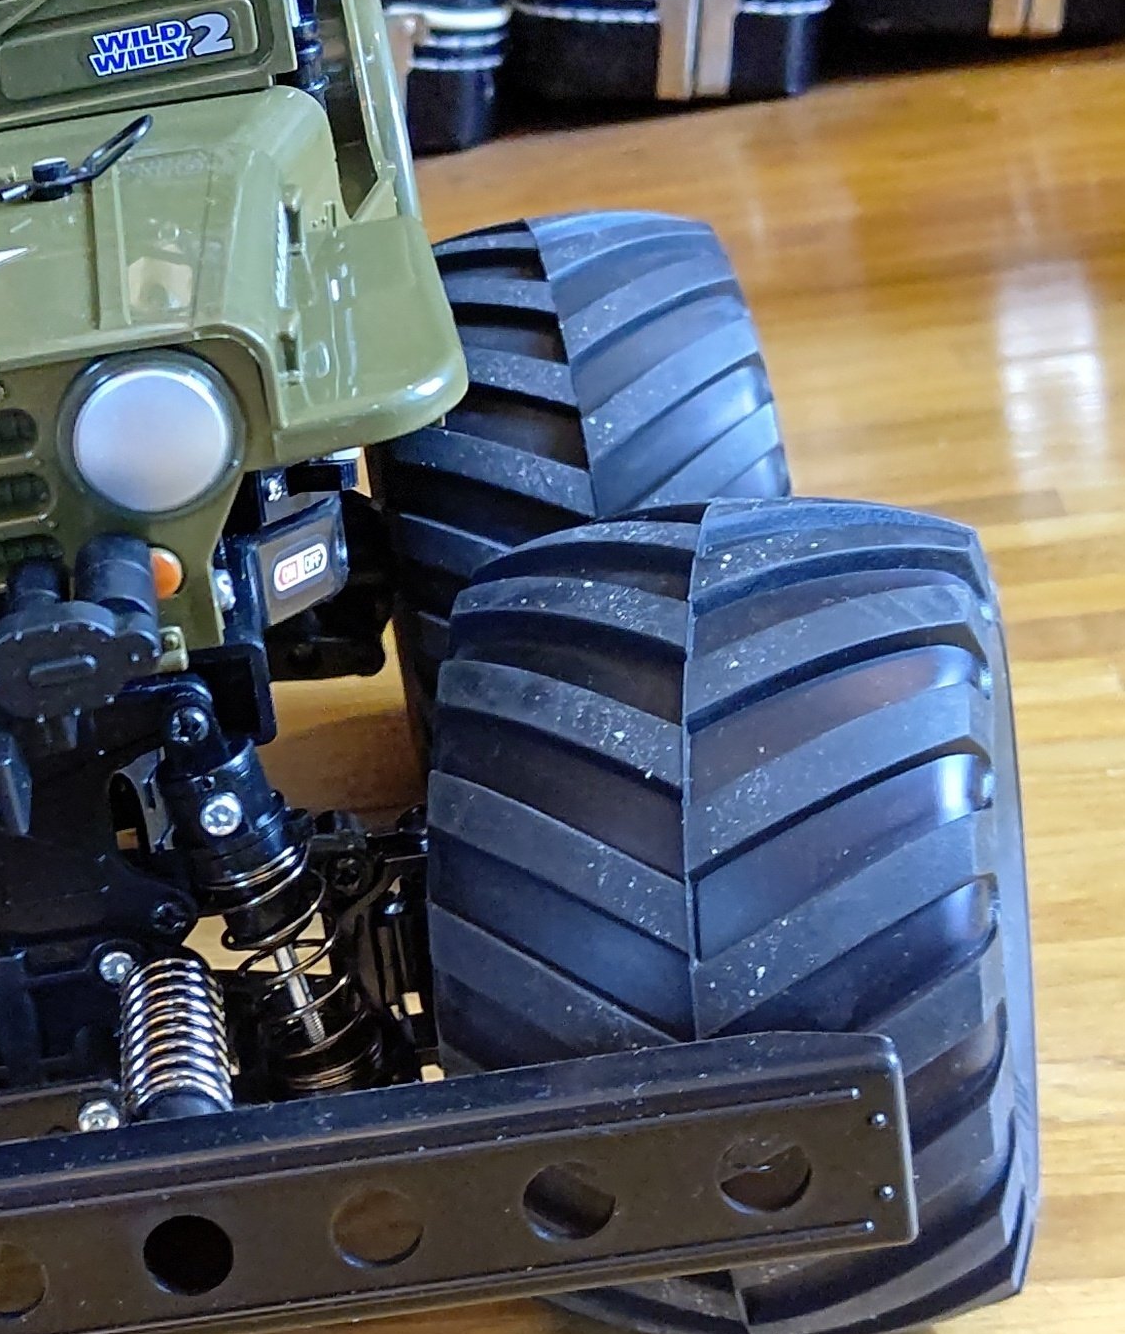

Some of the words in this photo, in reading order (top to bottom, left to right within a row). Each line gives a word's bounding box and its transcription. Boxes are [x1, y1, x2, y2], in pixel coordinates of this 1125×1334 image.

[89, 35, 193, 76] WILLY
[186, 12, 235, 57] 2
[93, 21, 186, 55] WILD
